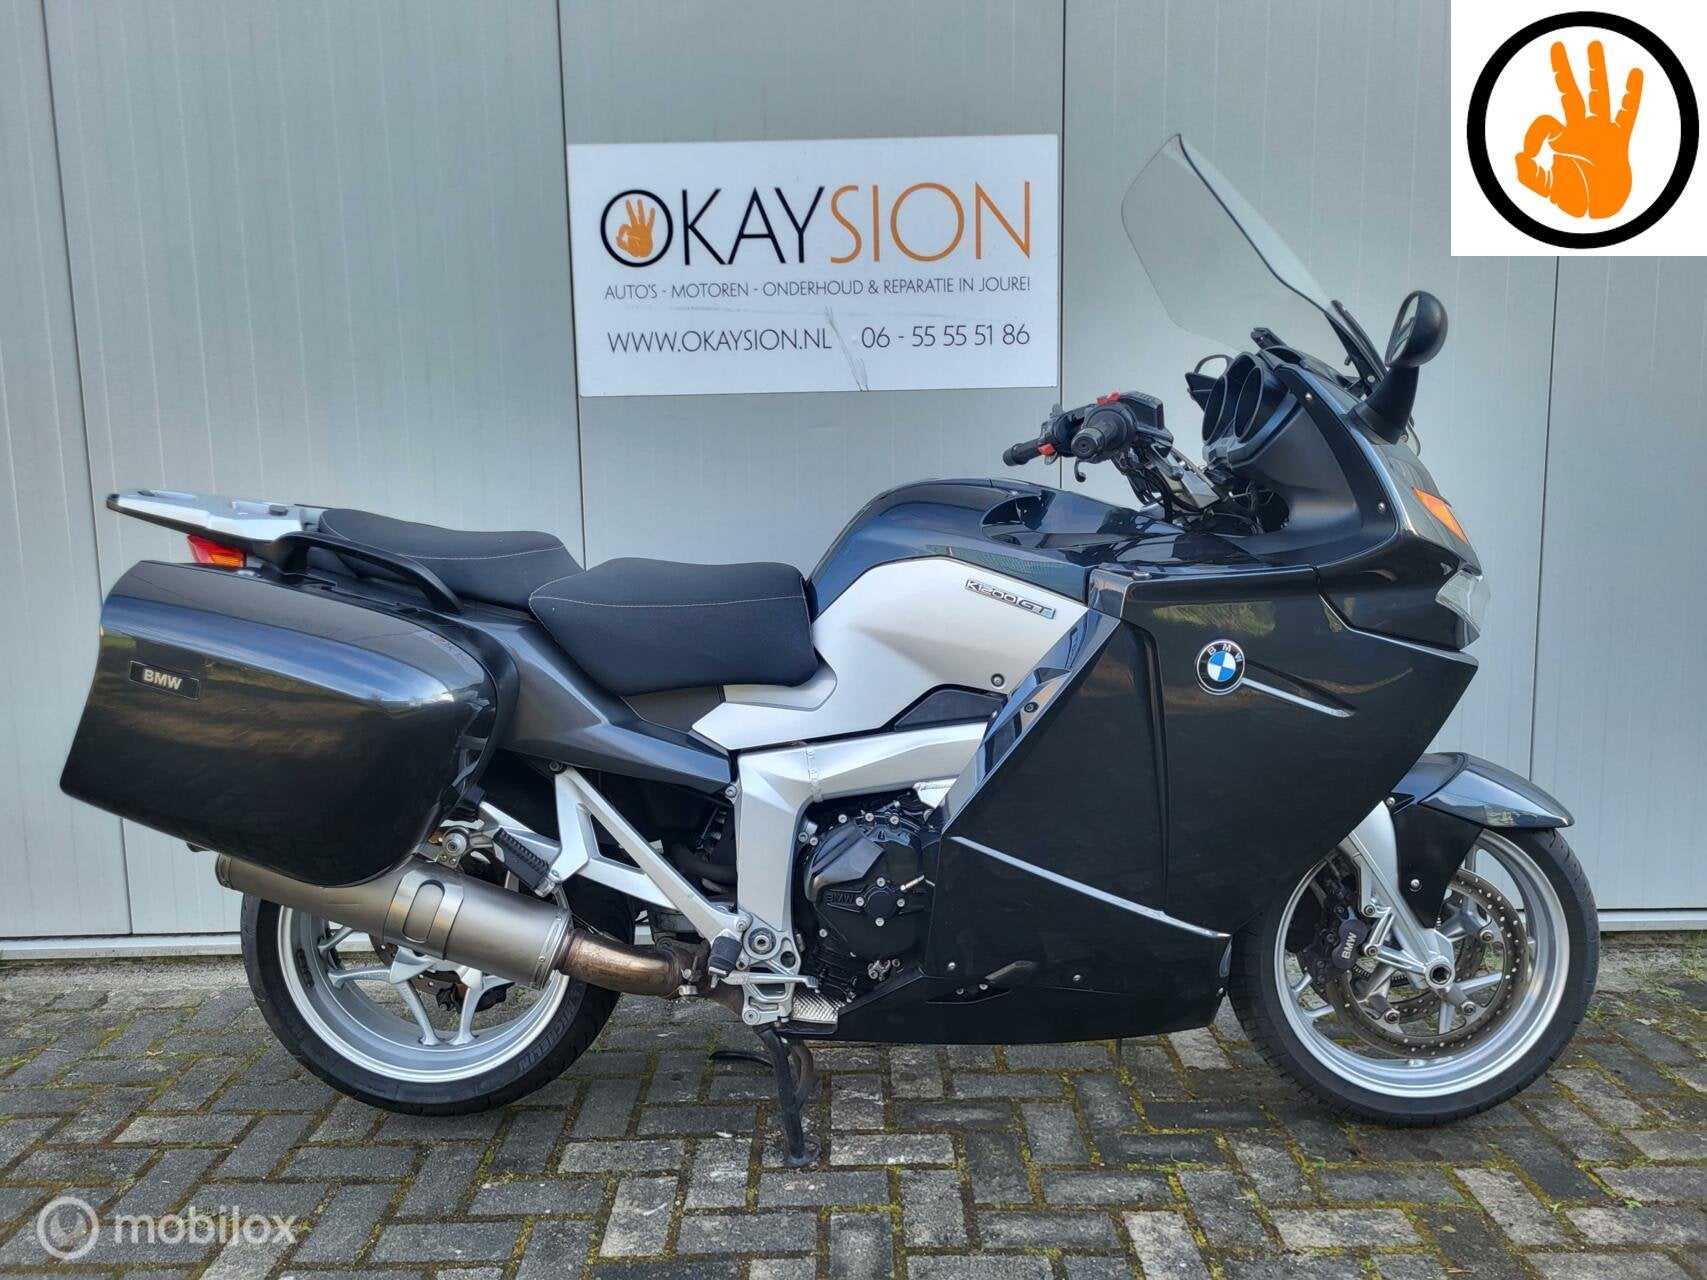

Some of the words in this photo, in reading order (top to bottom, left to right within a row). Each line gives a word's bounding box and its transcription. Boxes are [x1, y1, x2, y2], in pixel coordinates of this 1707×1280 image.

[600, 181, 1031, 268] OKAYSION
[604, 283, 658, 300] AUTO'S
[671, 282, 749, 299] MOTOREN
[762, 279, 864, 297] ONDERHOUD
[868, 279, 880, 295] &
[883, 277, 955, 295] REPARATIE
[958, 276, 974, 293] IN
[978, 275, 1031, 293] JOURE!
[606, 327, 832, 354] WWW.OKAYSION.NL
[861, 326, 891, 350] 06
[911, 325, 936, 348] 55
[942, 324, 968, 347] 55
[974, 323, 993, 346] 51
[1001, 322, 1031, 346] 86
[143, 668, 183, 690] BMW
[1341, 931, 1357, 959] BMW
